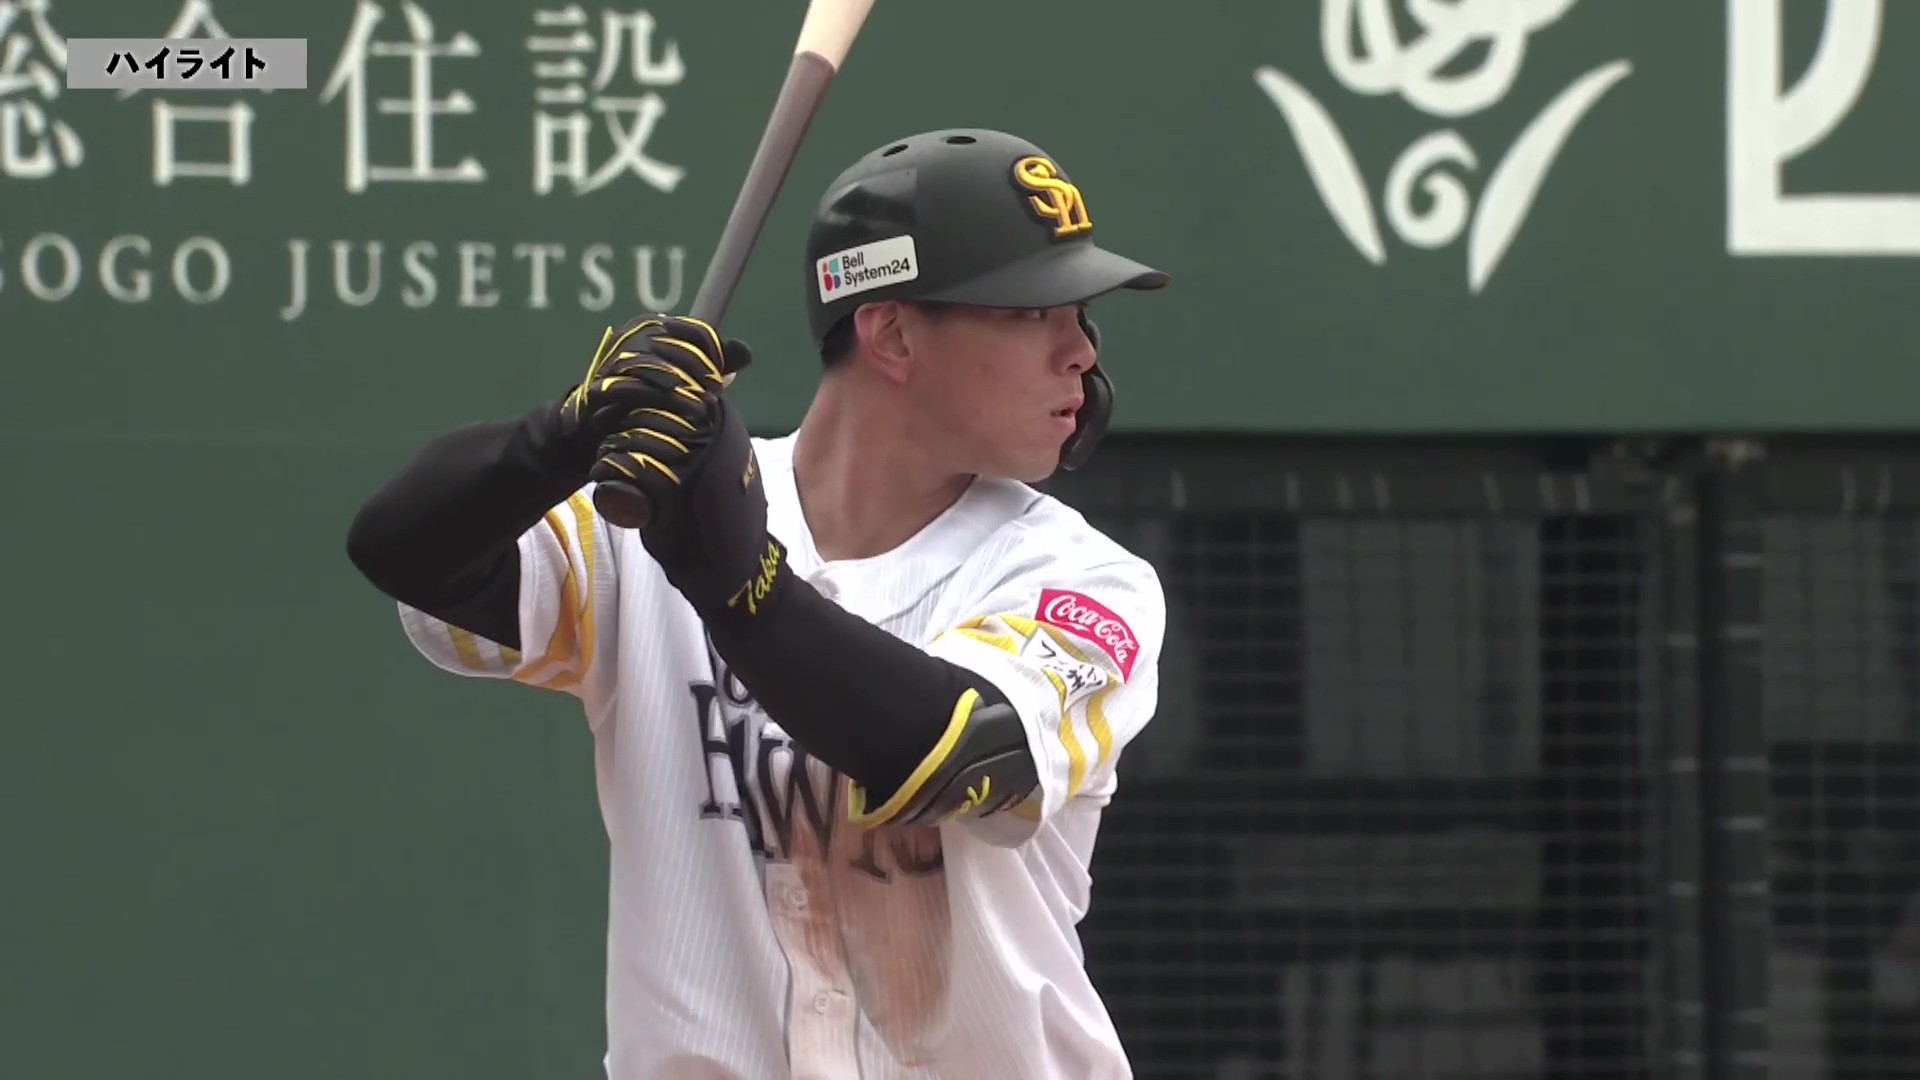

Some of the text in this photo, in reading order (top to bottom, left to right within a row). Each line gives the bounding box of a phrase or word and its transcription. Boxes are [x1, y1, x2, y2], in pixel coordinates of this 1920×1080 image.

[842, 251, 864, 270] Bell
[844, 257, 911, 288] System24
[0, 232, 688, 321] OGO JUSETSU
